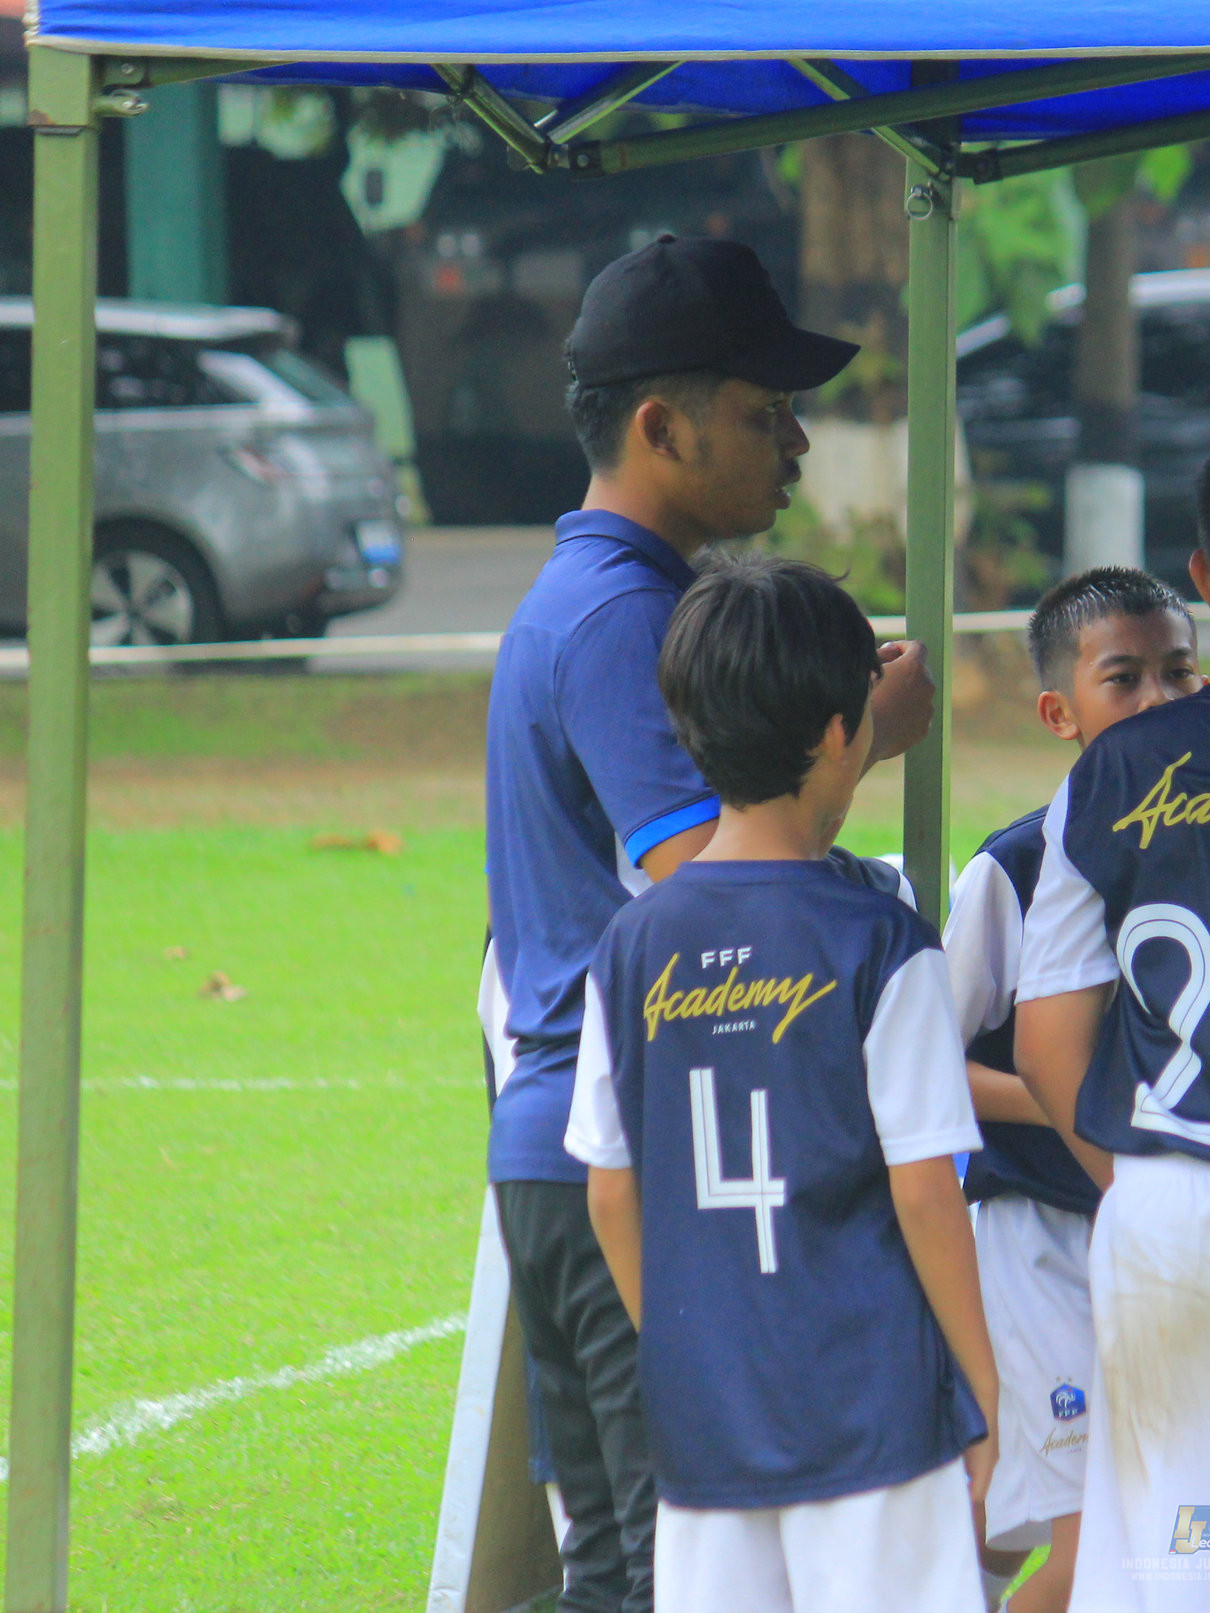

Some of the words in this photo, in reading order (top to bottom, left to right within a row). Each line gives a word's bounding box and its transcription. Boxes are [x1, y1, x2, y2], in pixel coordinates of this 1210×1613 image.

[701, 946, 752, 968] FFF
[644, 952, 837, 1044] Academy
[712, 1020, 756, 1035] JAKARTA
[689, 1067, 786, 1274] 4
